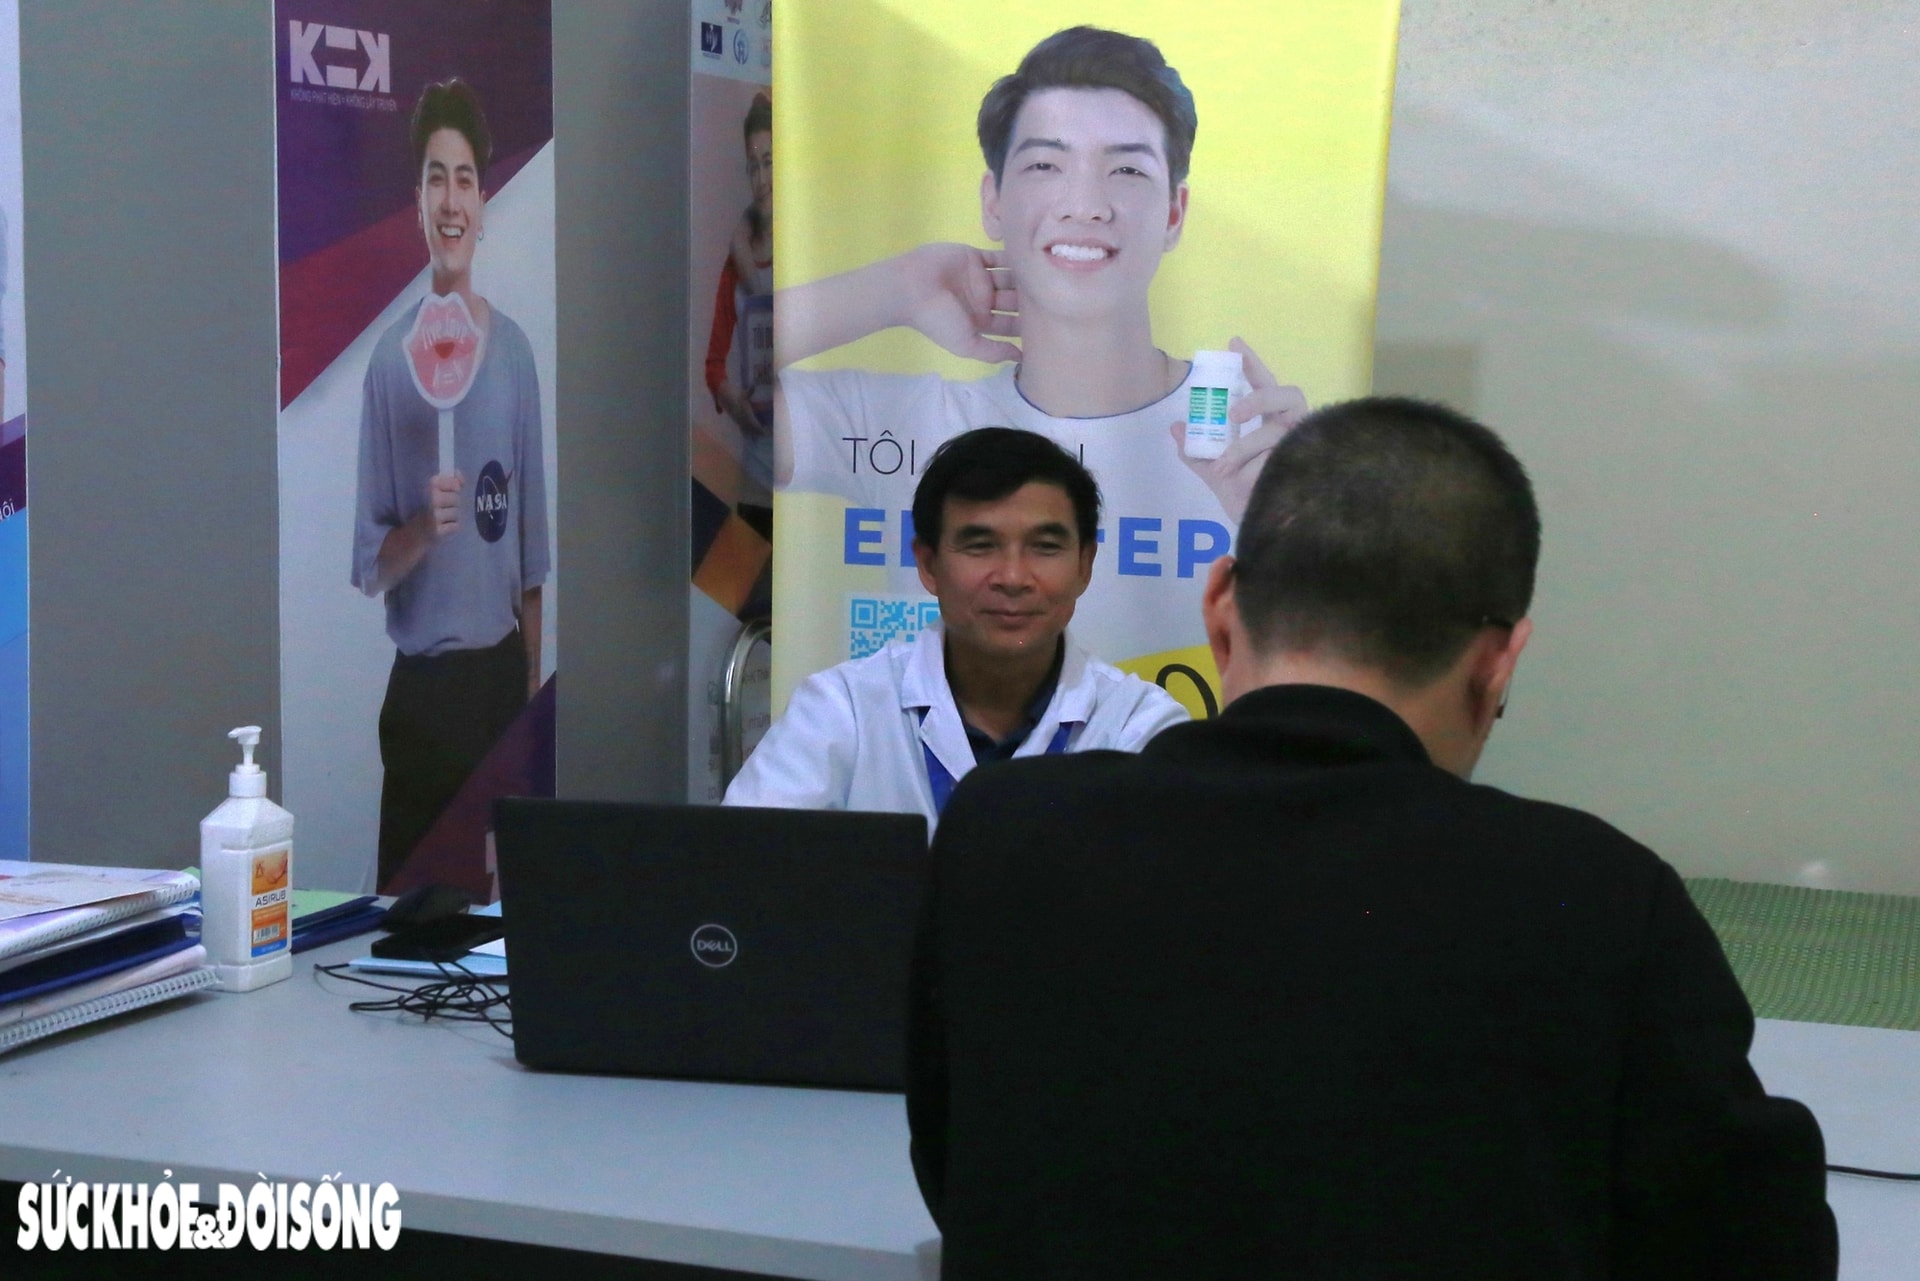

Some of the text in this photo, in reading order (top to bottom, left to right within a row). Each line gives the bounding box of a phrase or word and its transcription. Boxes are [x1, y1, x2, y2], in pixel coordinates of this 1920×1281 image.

[842, 430, 915, 475] TÔI
[477, 493, 508, 512] NASA
[255, 891, 286, 906] ASIRUB
[697, 939, 733, 952] DELL
